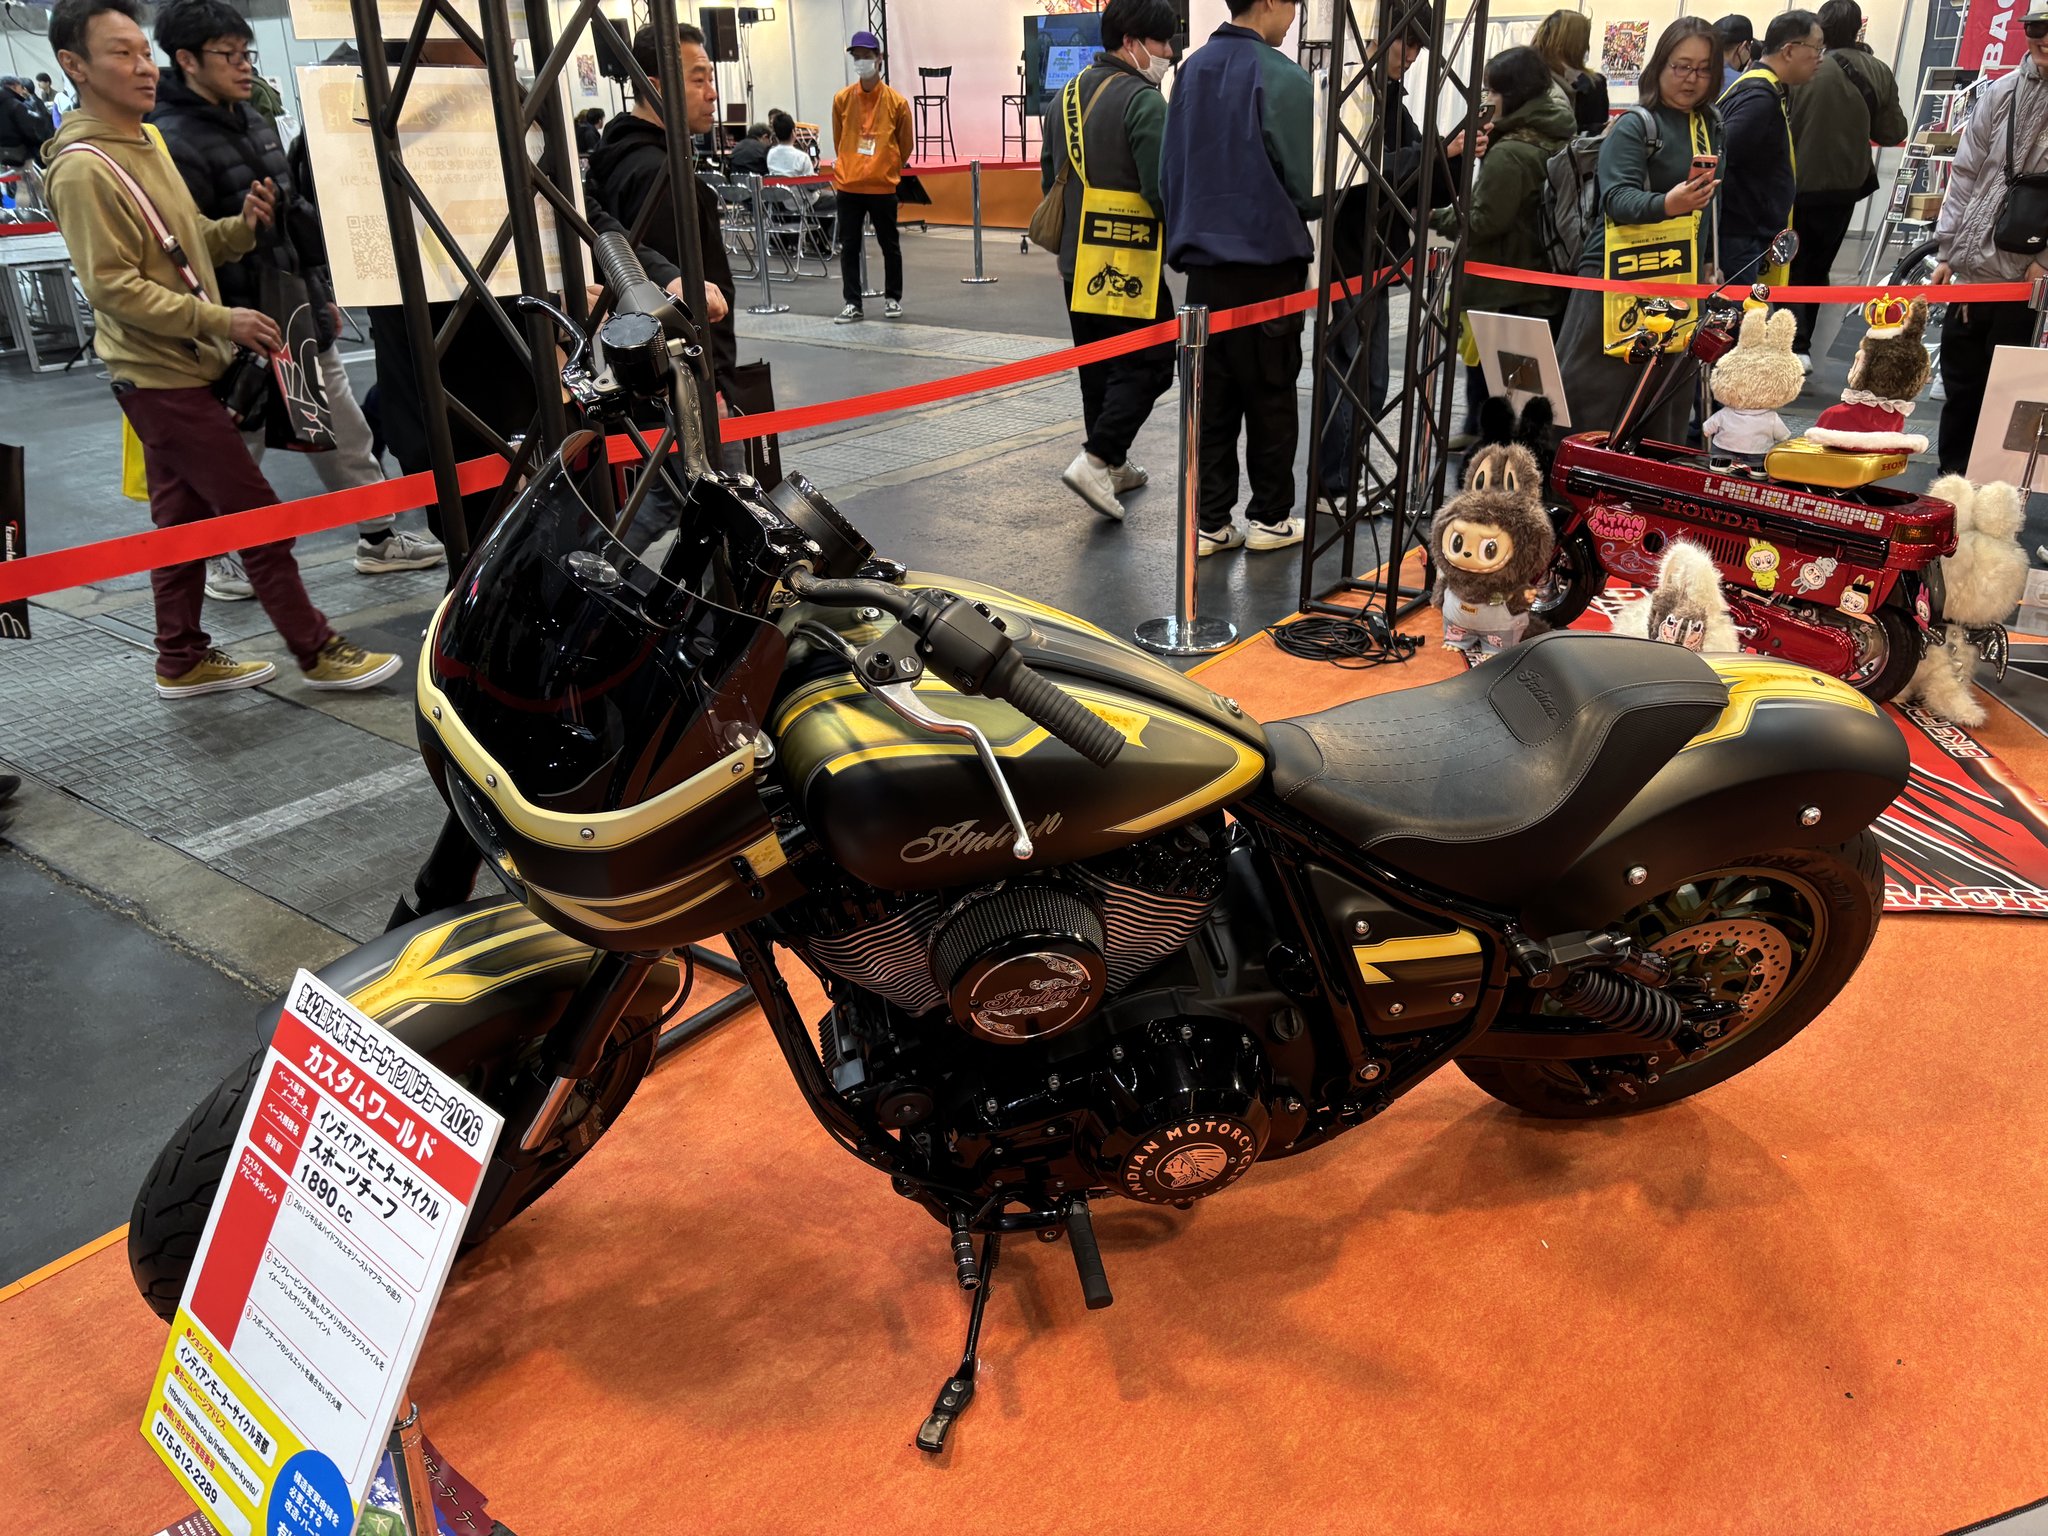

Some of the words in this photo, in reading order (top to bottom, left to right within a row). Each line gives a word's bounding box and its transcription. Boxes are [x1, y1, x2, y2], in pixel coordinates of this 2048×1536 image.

[1093, 219, 1150, 243] コミネ
[1617, 248, 1683, 275] コミネ
[1589, 518, 1641, 541] RACING
[1594, 508, 1645, 531] KITTAN
[1662, 497, 1763, 534] HONDA
[1516, 669, 1560, 720] Indian
[983, 986, 1079, 1010] Indian
[296, 983, 483, 1147] 第42回大阪モーターサイクルショー2026
[281, 1089, 309, 1117] メーカー名
[304, 1044, 438, 1161] カスタムワールド
[243, 1153, 264, 1177] カスタム
[309, 1135, 399, 1220] スポーツチーフ
[320, 1110, 440, 1222] インディアンモーターサイクル
[1127, 1140, 1160, 1196] INDIAN
[1166, 1121, 1252, 1181] MOTORCYCLE
[239, 1165, 278, 1205] アピールポイント
[300, 1164, 338, 1208] 1890
[337, 1203, 353, 1224] cc
[190, 1332, 215, 1365] ショップ名
[178, 1370, 227, 1432] ホームページアドレス
[180, 1346, 271, 1456] インディアンモーターサイクル京都
[156, 1421, 218, 1505] 075-612-2289
[284, 1498, 320, 1536] 改造・パー
[288, 1485, 323, 1528] 必要とする
